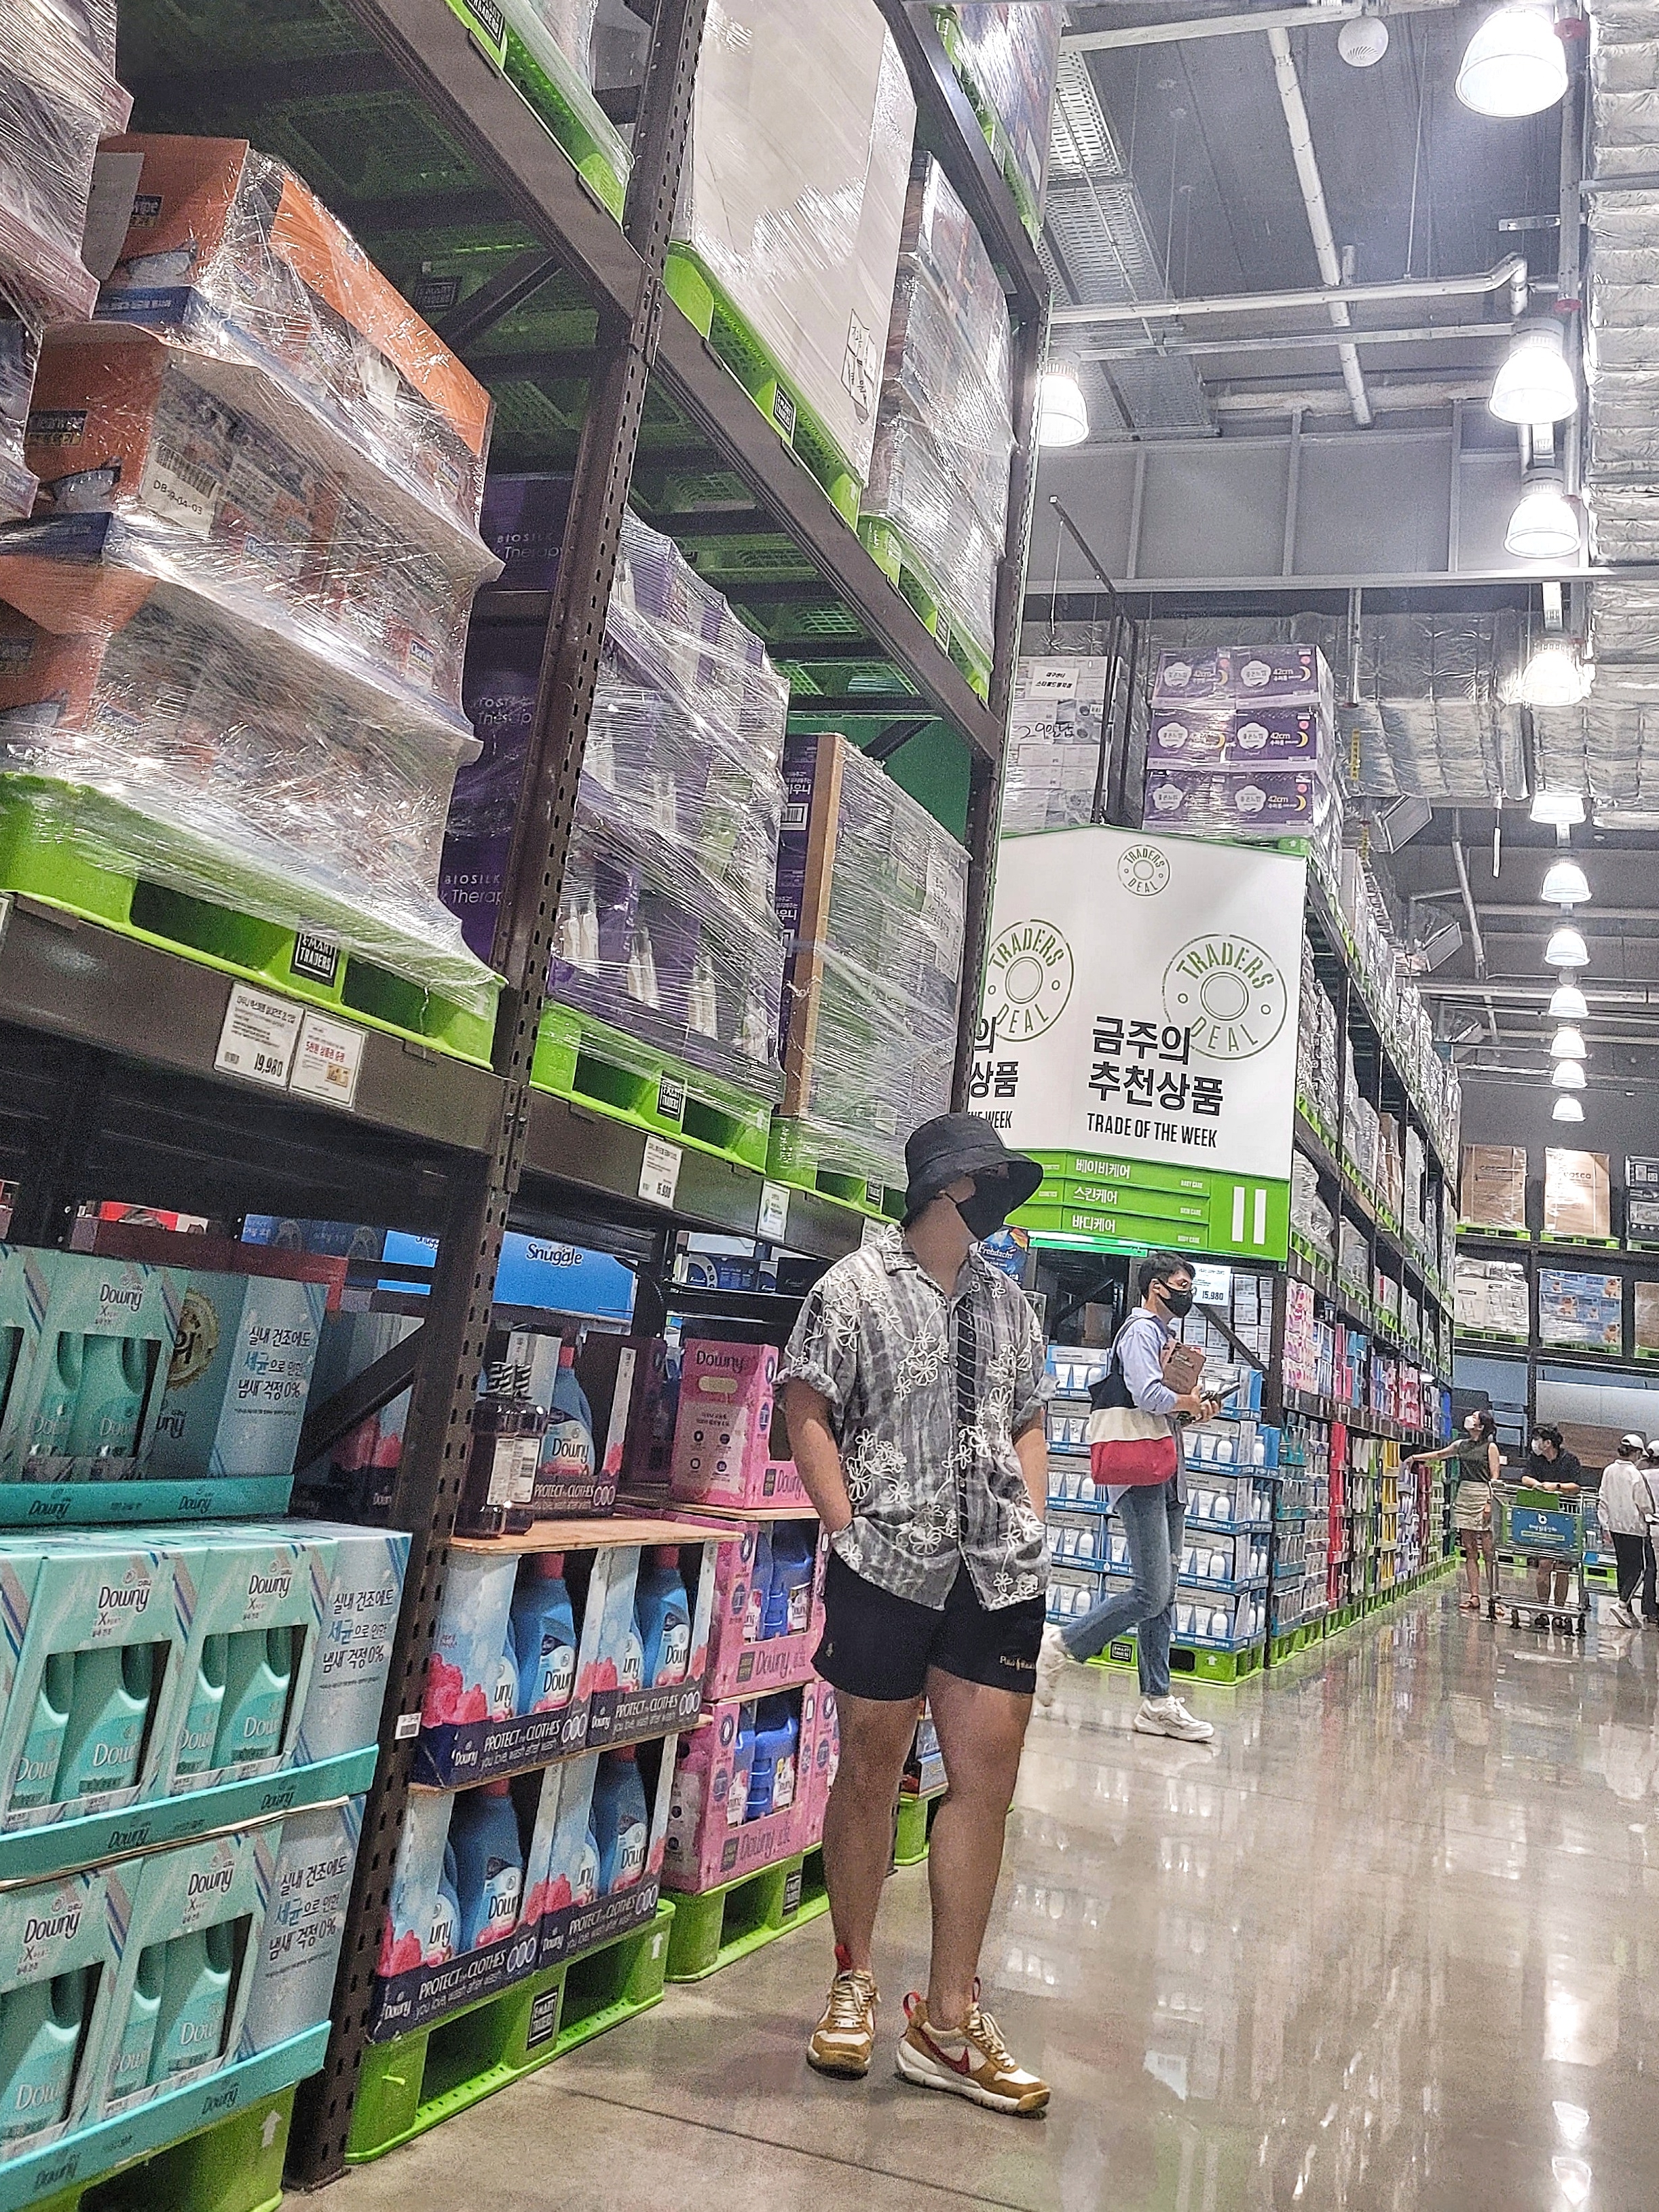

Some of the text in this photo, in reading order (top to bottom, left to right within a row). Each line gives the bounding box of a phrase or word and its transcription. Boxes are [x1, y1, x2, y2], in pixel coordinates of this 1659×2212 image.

[1123, 848, 1165, 868] TRADERS
[1127, 878, 1158, 893] DEAL
[300, 947, 332, 971] TRADERS
[988, 928, 1064, 970] TRADERS
[1176, 941, 1275, 990] TRADERS
[996, 1004, 1049, 1033] DEAL
[1092, 1015, 1191, 1066] 금주의
[1191, 1015, 1259, 1052] DEAL
[254, 1053, 284, 1077] 19,980
[1088, 1062, 1223, 1117] 추천상품
[1087, 1113, 1218, 1148] TRADE OF THE WEEK
[1075, 1158, 1131, 1180] 베이비케어
[1073, 1186, 1118, 1205] 스킨케어
[1072, 1214, 1115, 1233] 바디케어
[1231, 1186, 1267, 1245] 11
[526, 1243, 582, 1267] Snuggle
[100, 1284, 143, 1312] Downy
[1201, 1290, 1224, 1300] 15,980
[696, 1350, 745, 1374] Downy
[553, 1438, 590, 1464] Downy
[534, 1484, 595, 1497] PROTECT CLOTHES
[29, 1500, 71, 1519] Downy
[178, 1496, 212, 1513] Downy
[248, 1575, 291, 1598] Downy
[98, 1586, 149, 1613] Downy
[323, 1645, 384, 1674] 냄새 걱정 0%
[616, 1694, 678, 1719] PROTECT CLOTHES
[483, 1719, 561, 1752] PROTECT CLOTHES
[455, 1750, 478, 1767] Downy
[187, 1868, 234, 1896] Downy
[24, 1912, 81, 1944] Downy
[319, 1917, 337, 1939] 0%
[569, 1909, 601, 1936] PROTECT
[418, 1949, 507, 2000] PROTECT CLOTHES
